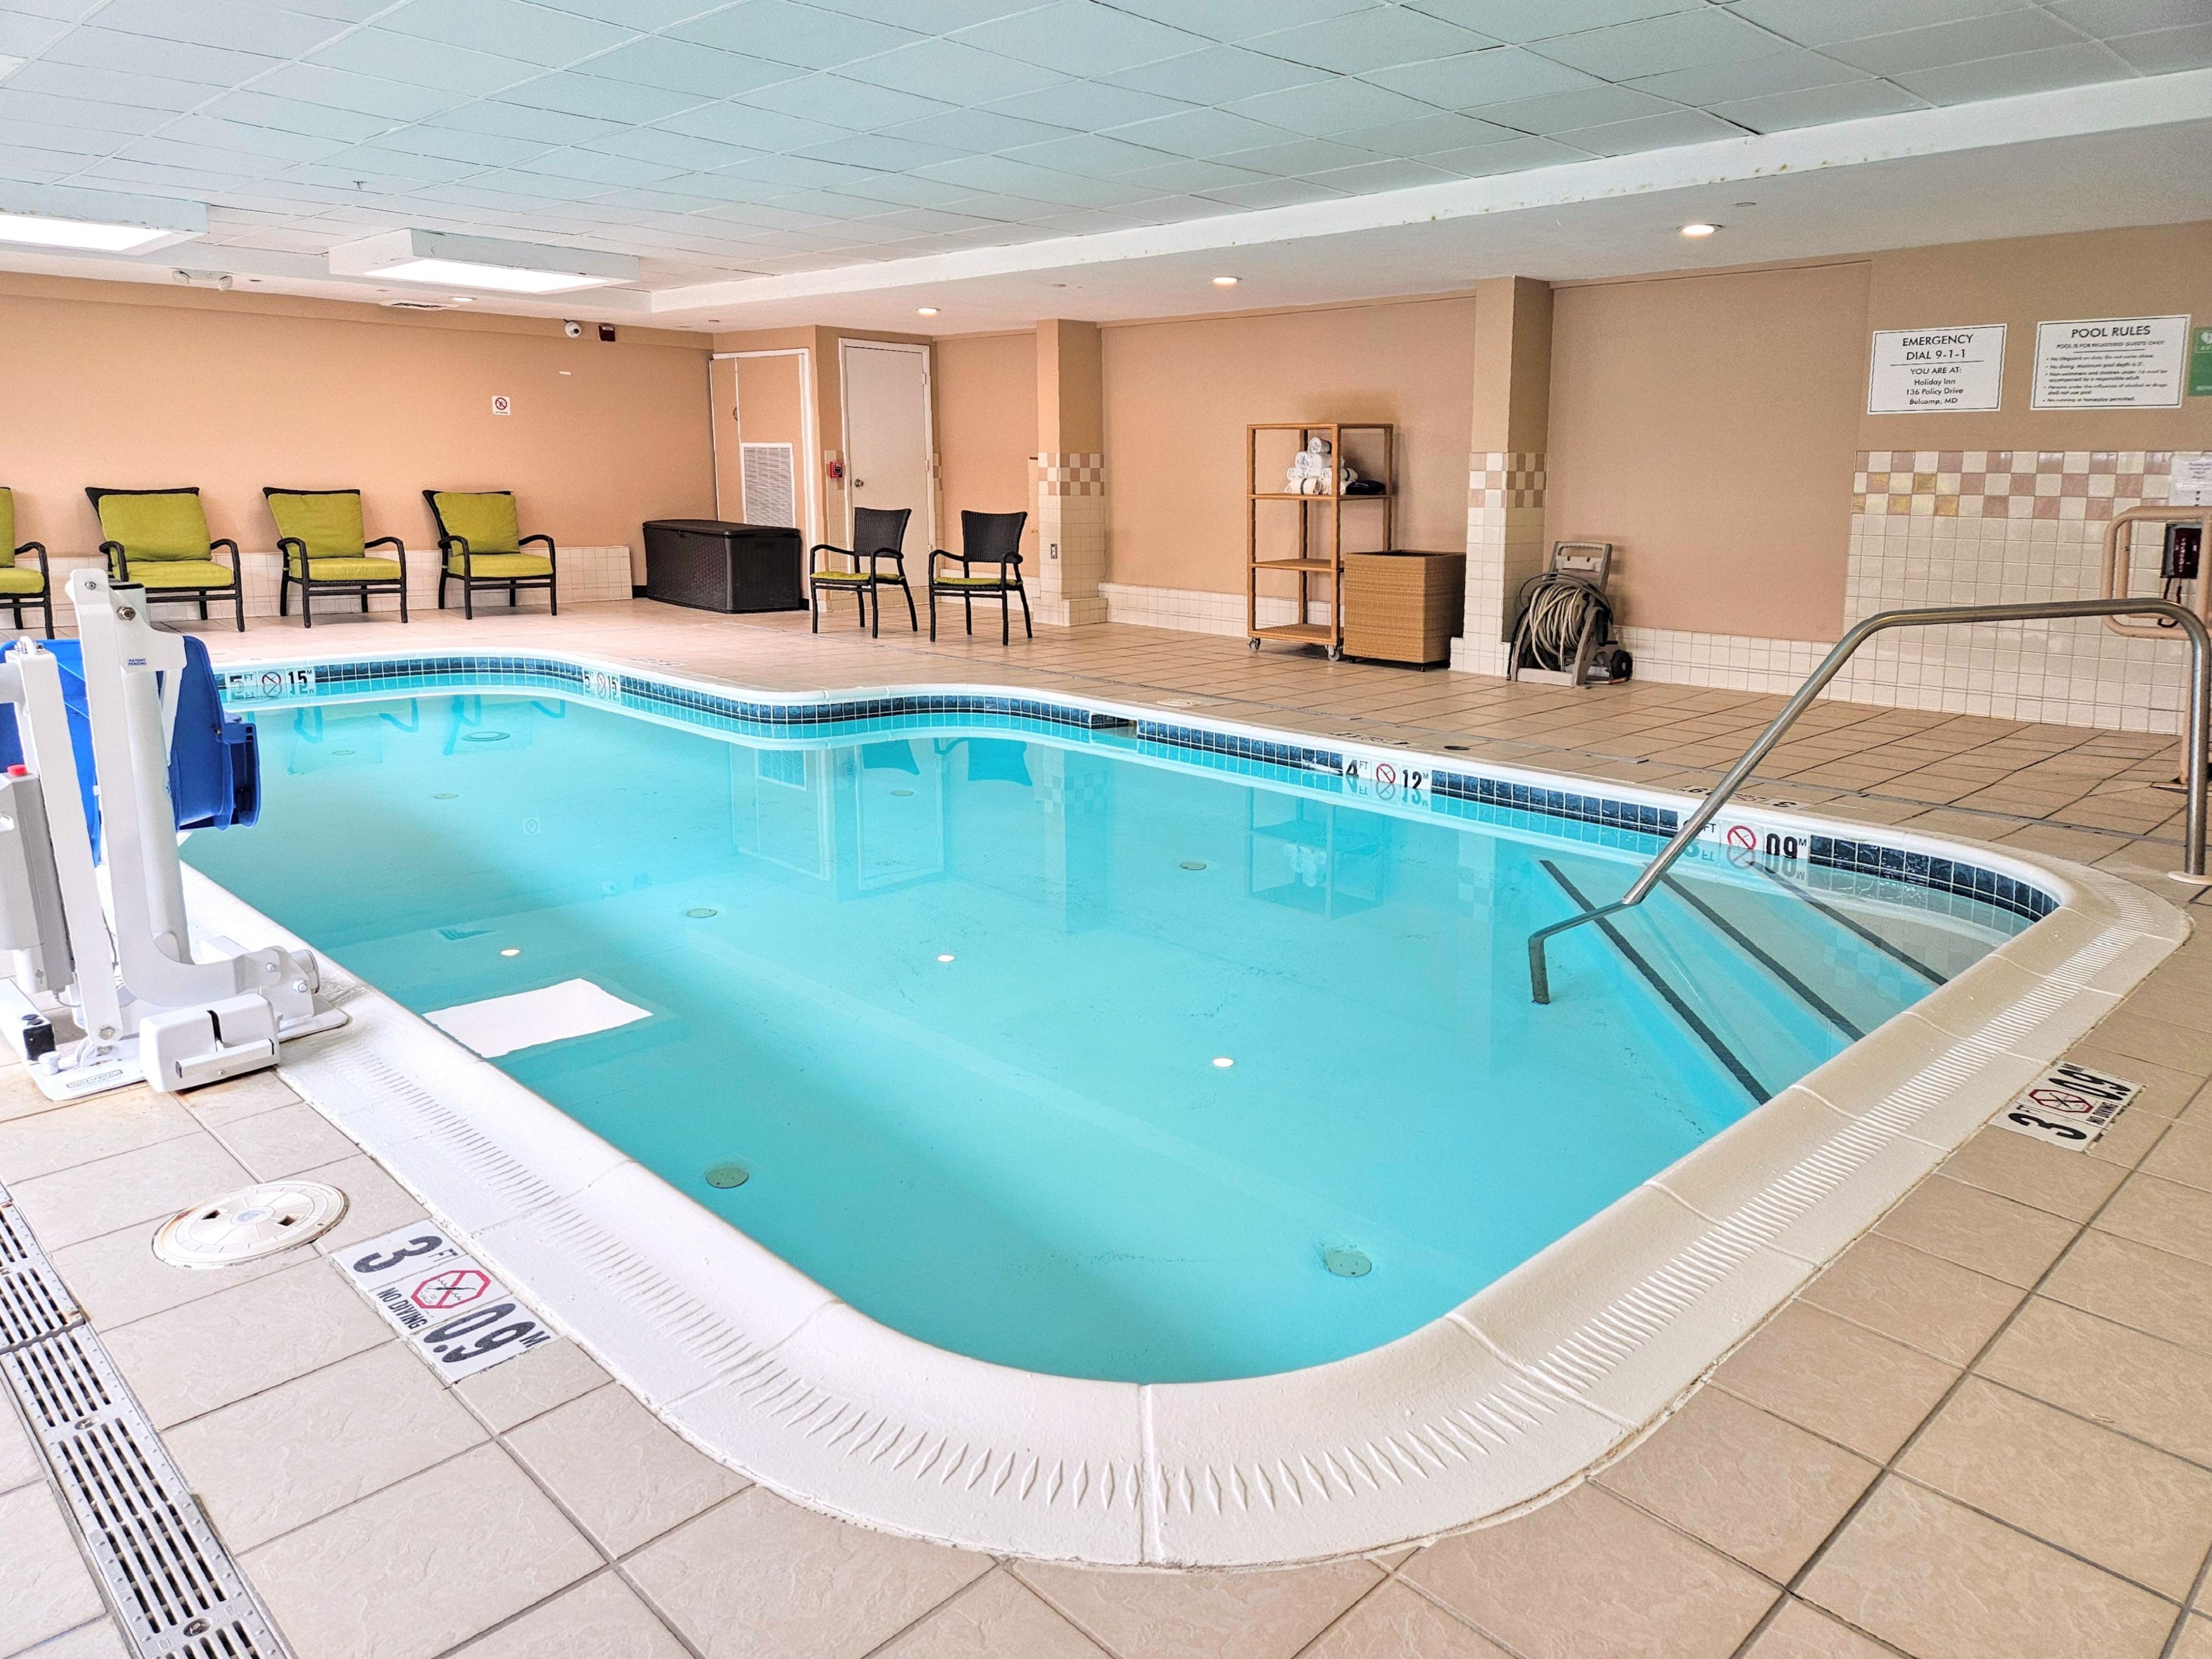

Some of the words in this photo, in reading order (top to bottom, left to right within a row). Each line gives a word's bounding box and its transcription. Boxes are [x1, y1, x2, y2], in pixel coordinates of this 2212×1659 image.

[2071, 327, 2107, 338] POOL
[2112, 326, 2151, 336] RULES
[1902, 334, 1974, 346] EMERGENCY
[1906, 351, 1932, 360] DIAL
[1935, 349, 1965, 359] 9-1-1
[584, 670, 590, 682] 5
[1345, 760, 1359, 778] 4
[1359, 760, 1369, 770] FT
[1402, 769, 1422, 789] 12
[1799, 838, 1807, 847] M
[2062, 1063, 2085, 1072] M
[2048, 1069, 2132, 1100] 0.9
[2016, 1104, 2042, 1115] FT
[2091, 1102, 2119, 1118] DIVING
[2008, 1113, 2087, 1140] 3
[2086, 1116, 2106, 1125] NO
[353, 1235, 443, 1273] 3
[429, 1248, 459, 1262] FT
[377, 1287, 402, 1302] NO
[388, 1300, 428, 1329] DIVING
[423, 1303, 536, 1363] 0.9
[519, 1330, 551, 1348] M
